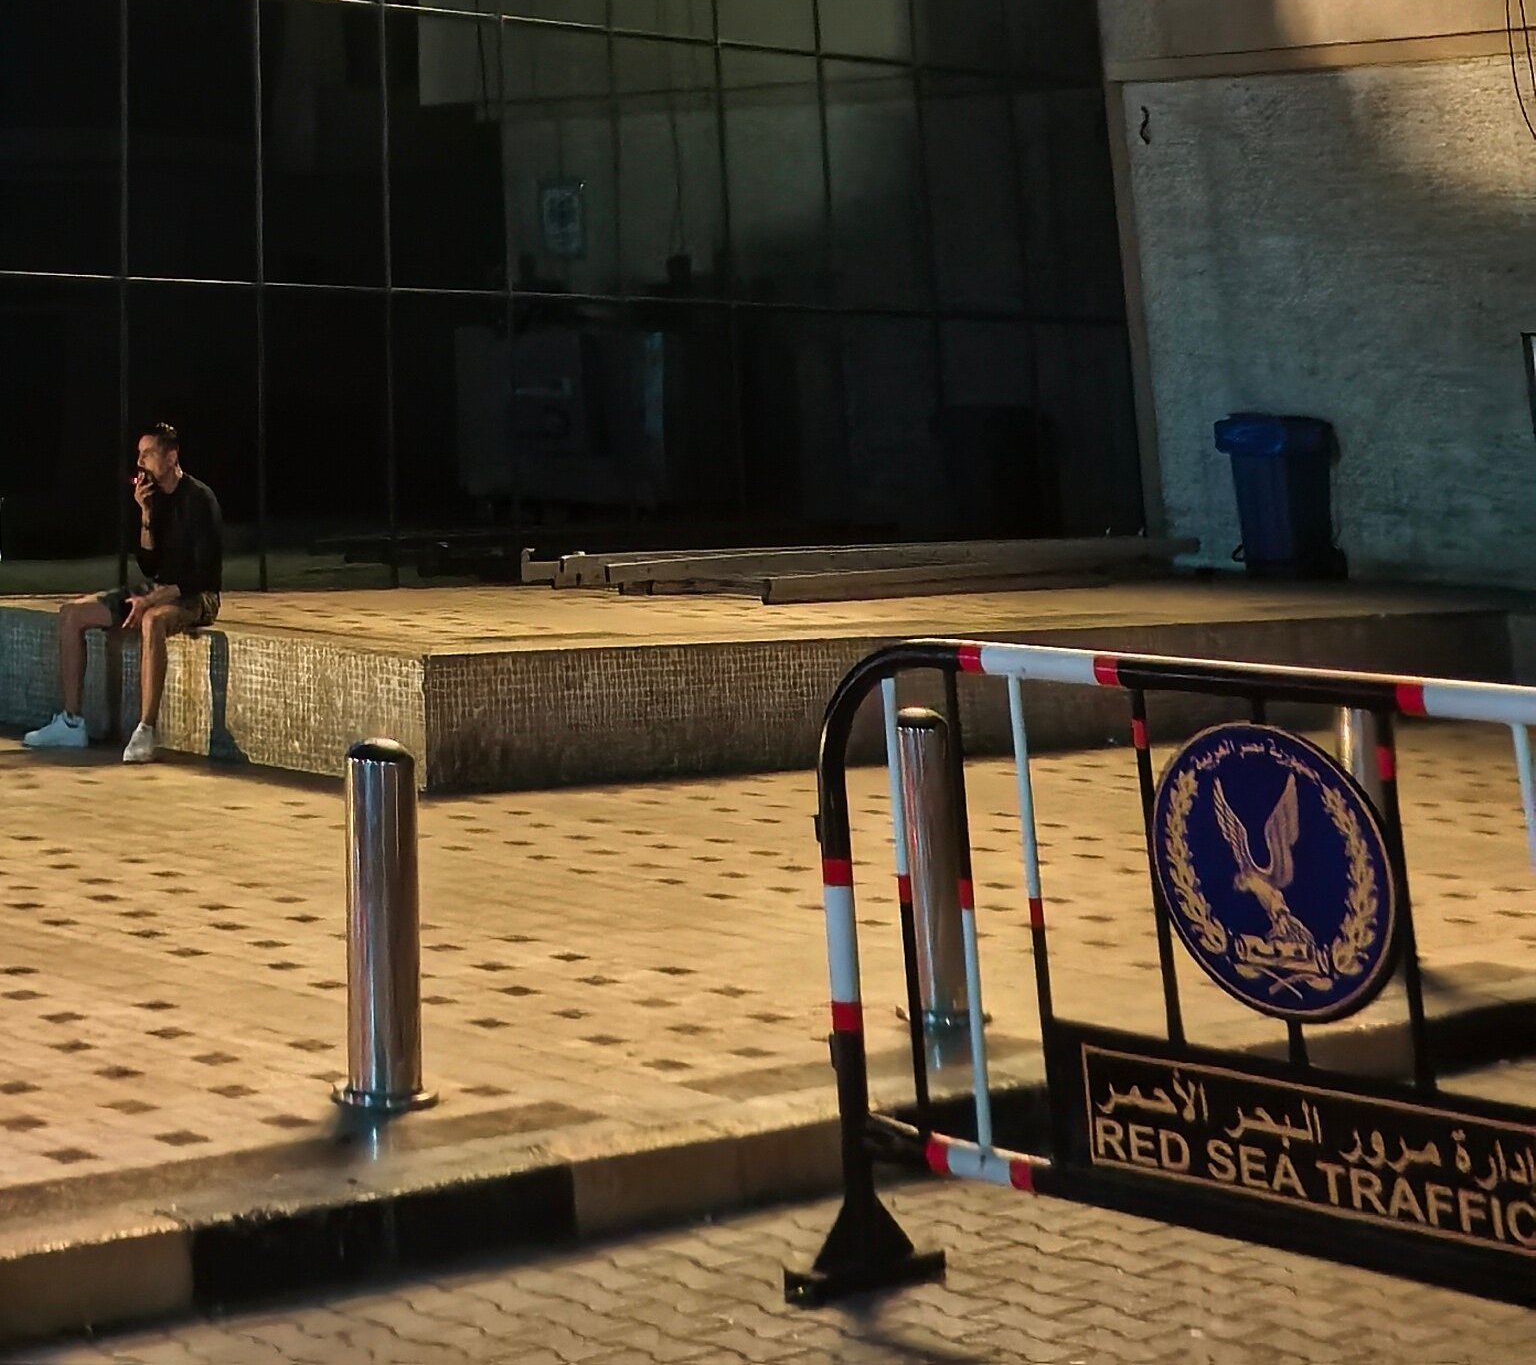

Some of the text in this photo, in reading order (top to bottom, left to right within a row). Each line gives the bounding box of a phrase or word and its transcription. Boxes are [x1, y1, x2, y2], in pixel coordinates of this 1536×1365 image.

[1224, 1098, 1322, 1150] البحر
[1339, 1127, 1442, 1173] مرور
[1095, 1116, 1536, 1248] RED SEA TRAFFIC
